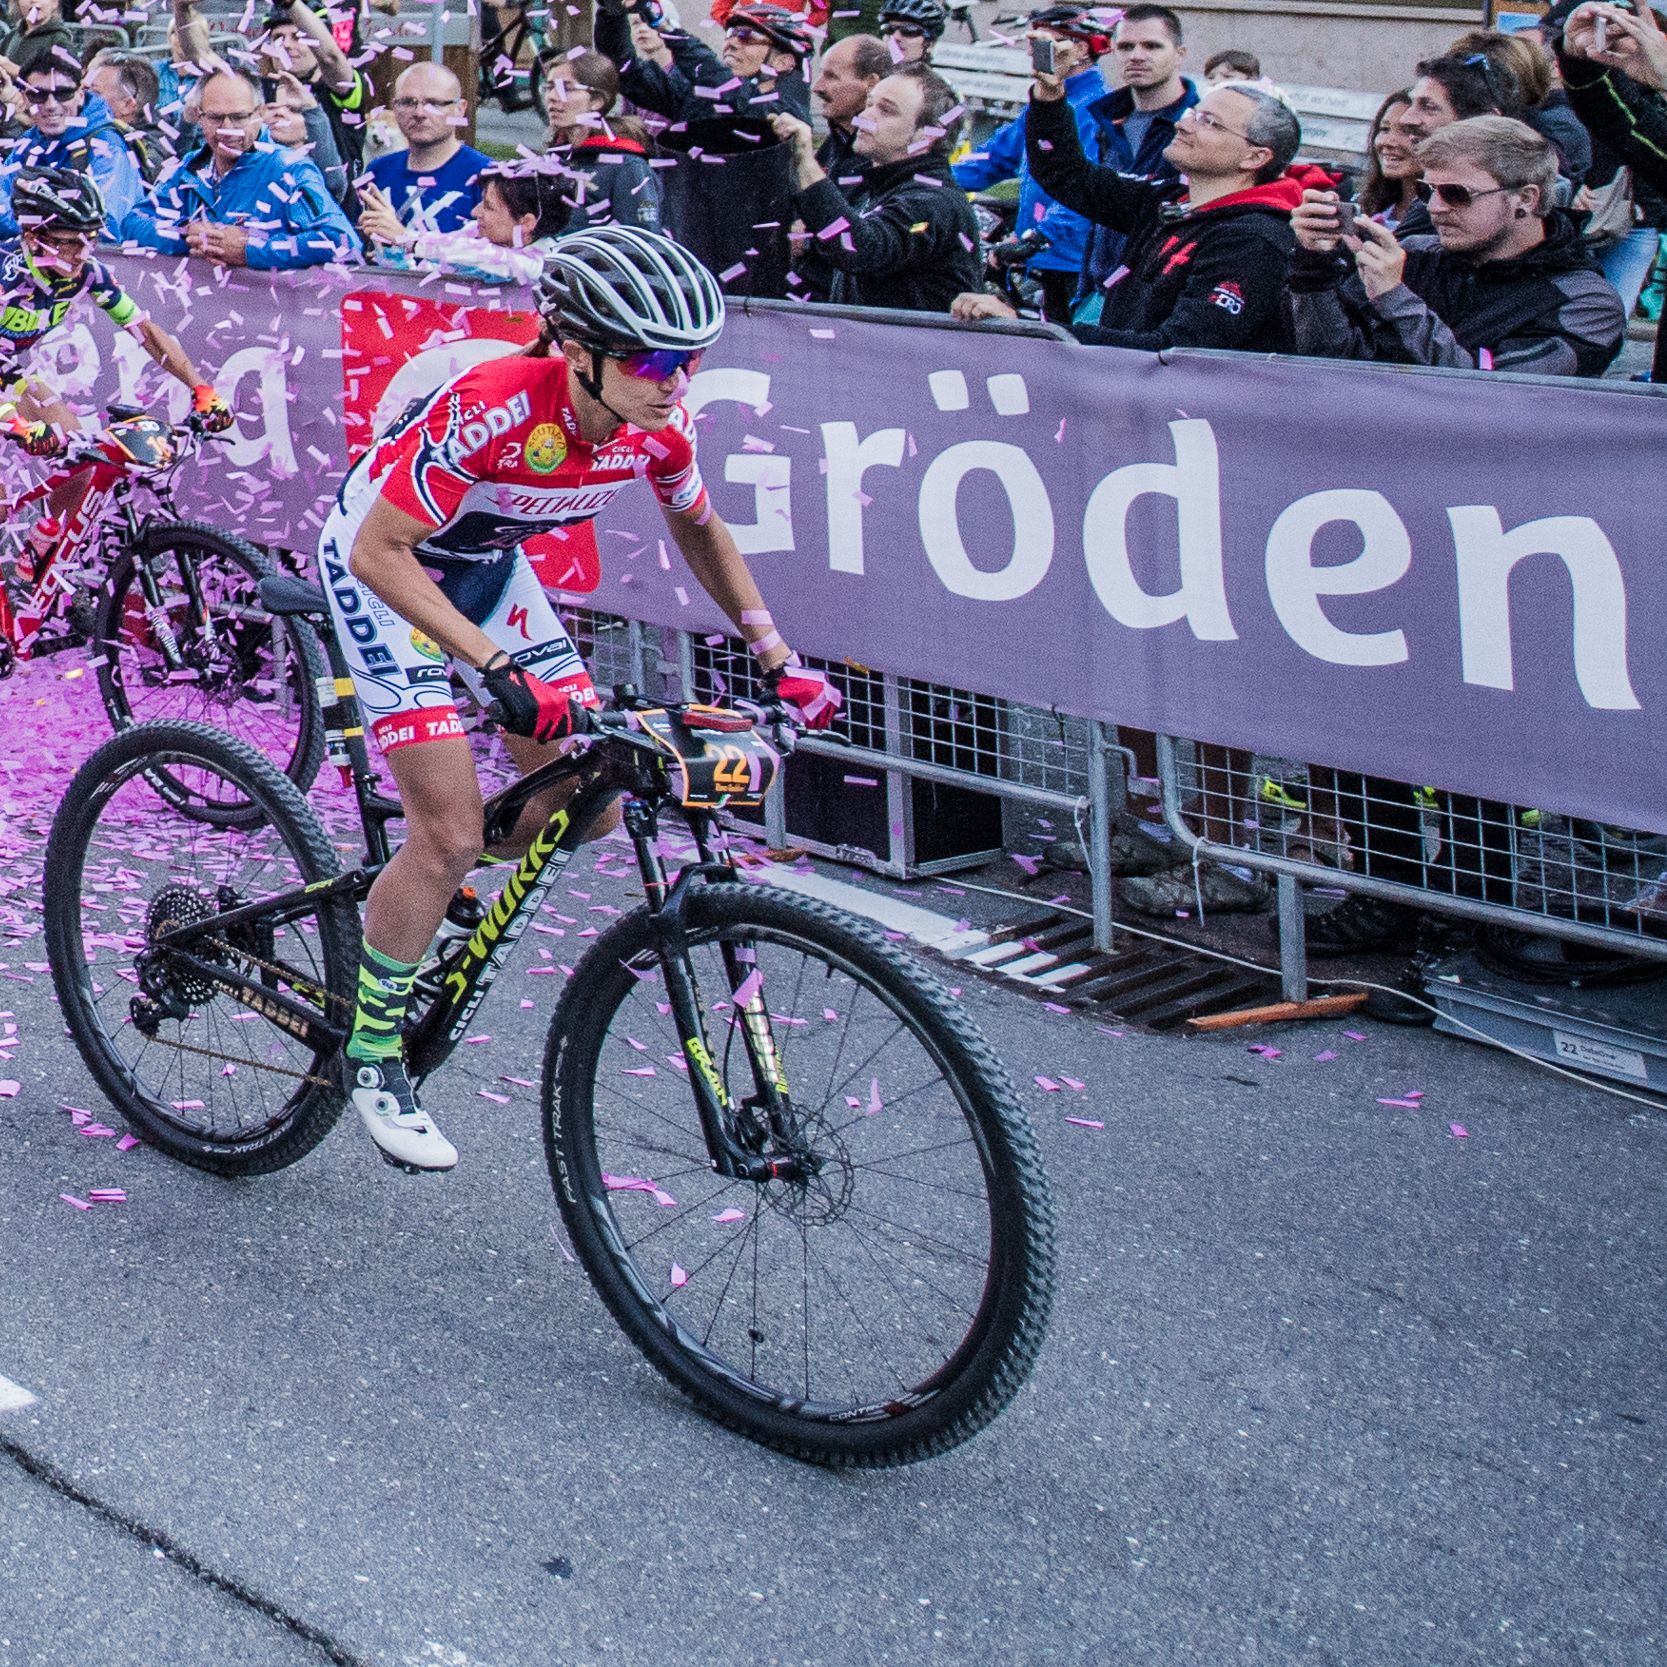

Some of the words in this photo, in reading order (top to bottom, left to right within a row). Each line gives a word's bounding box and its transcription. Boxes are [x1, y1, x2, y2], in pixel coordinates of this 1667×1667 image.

[429, 389, 533, 470] TADDEI
[684, 368, 1642, 710] Gröden
[320, 538, 400, 677] TADDEI
[414, 666, 446, 681] rov
[713, 743, 751, 782] 22
[480, 847, 573, 985] TADDEI
